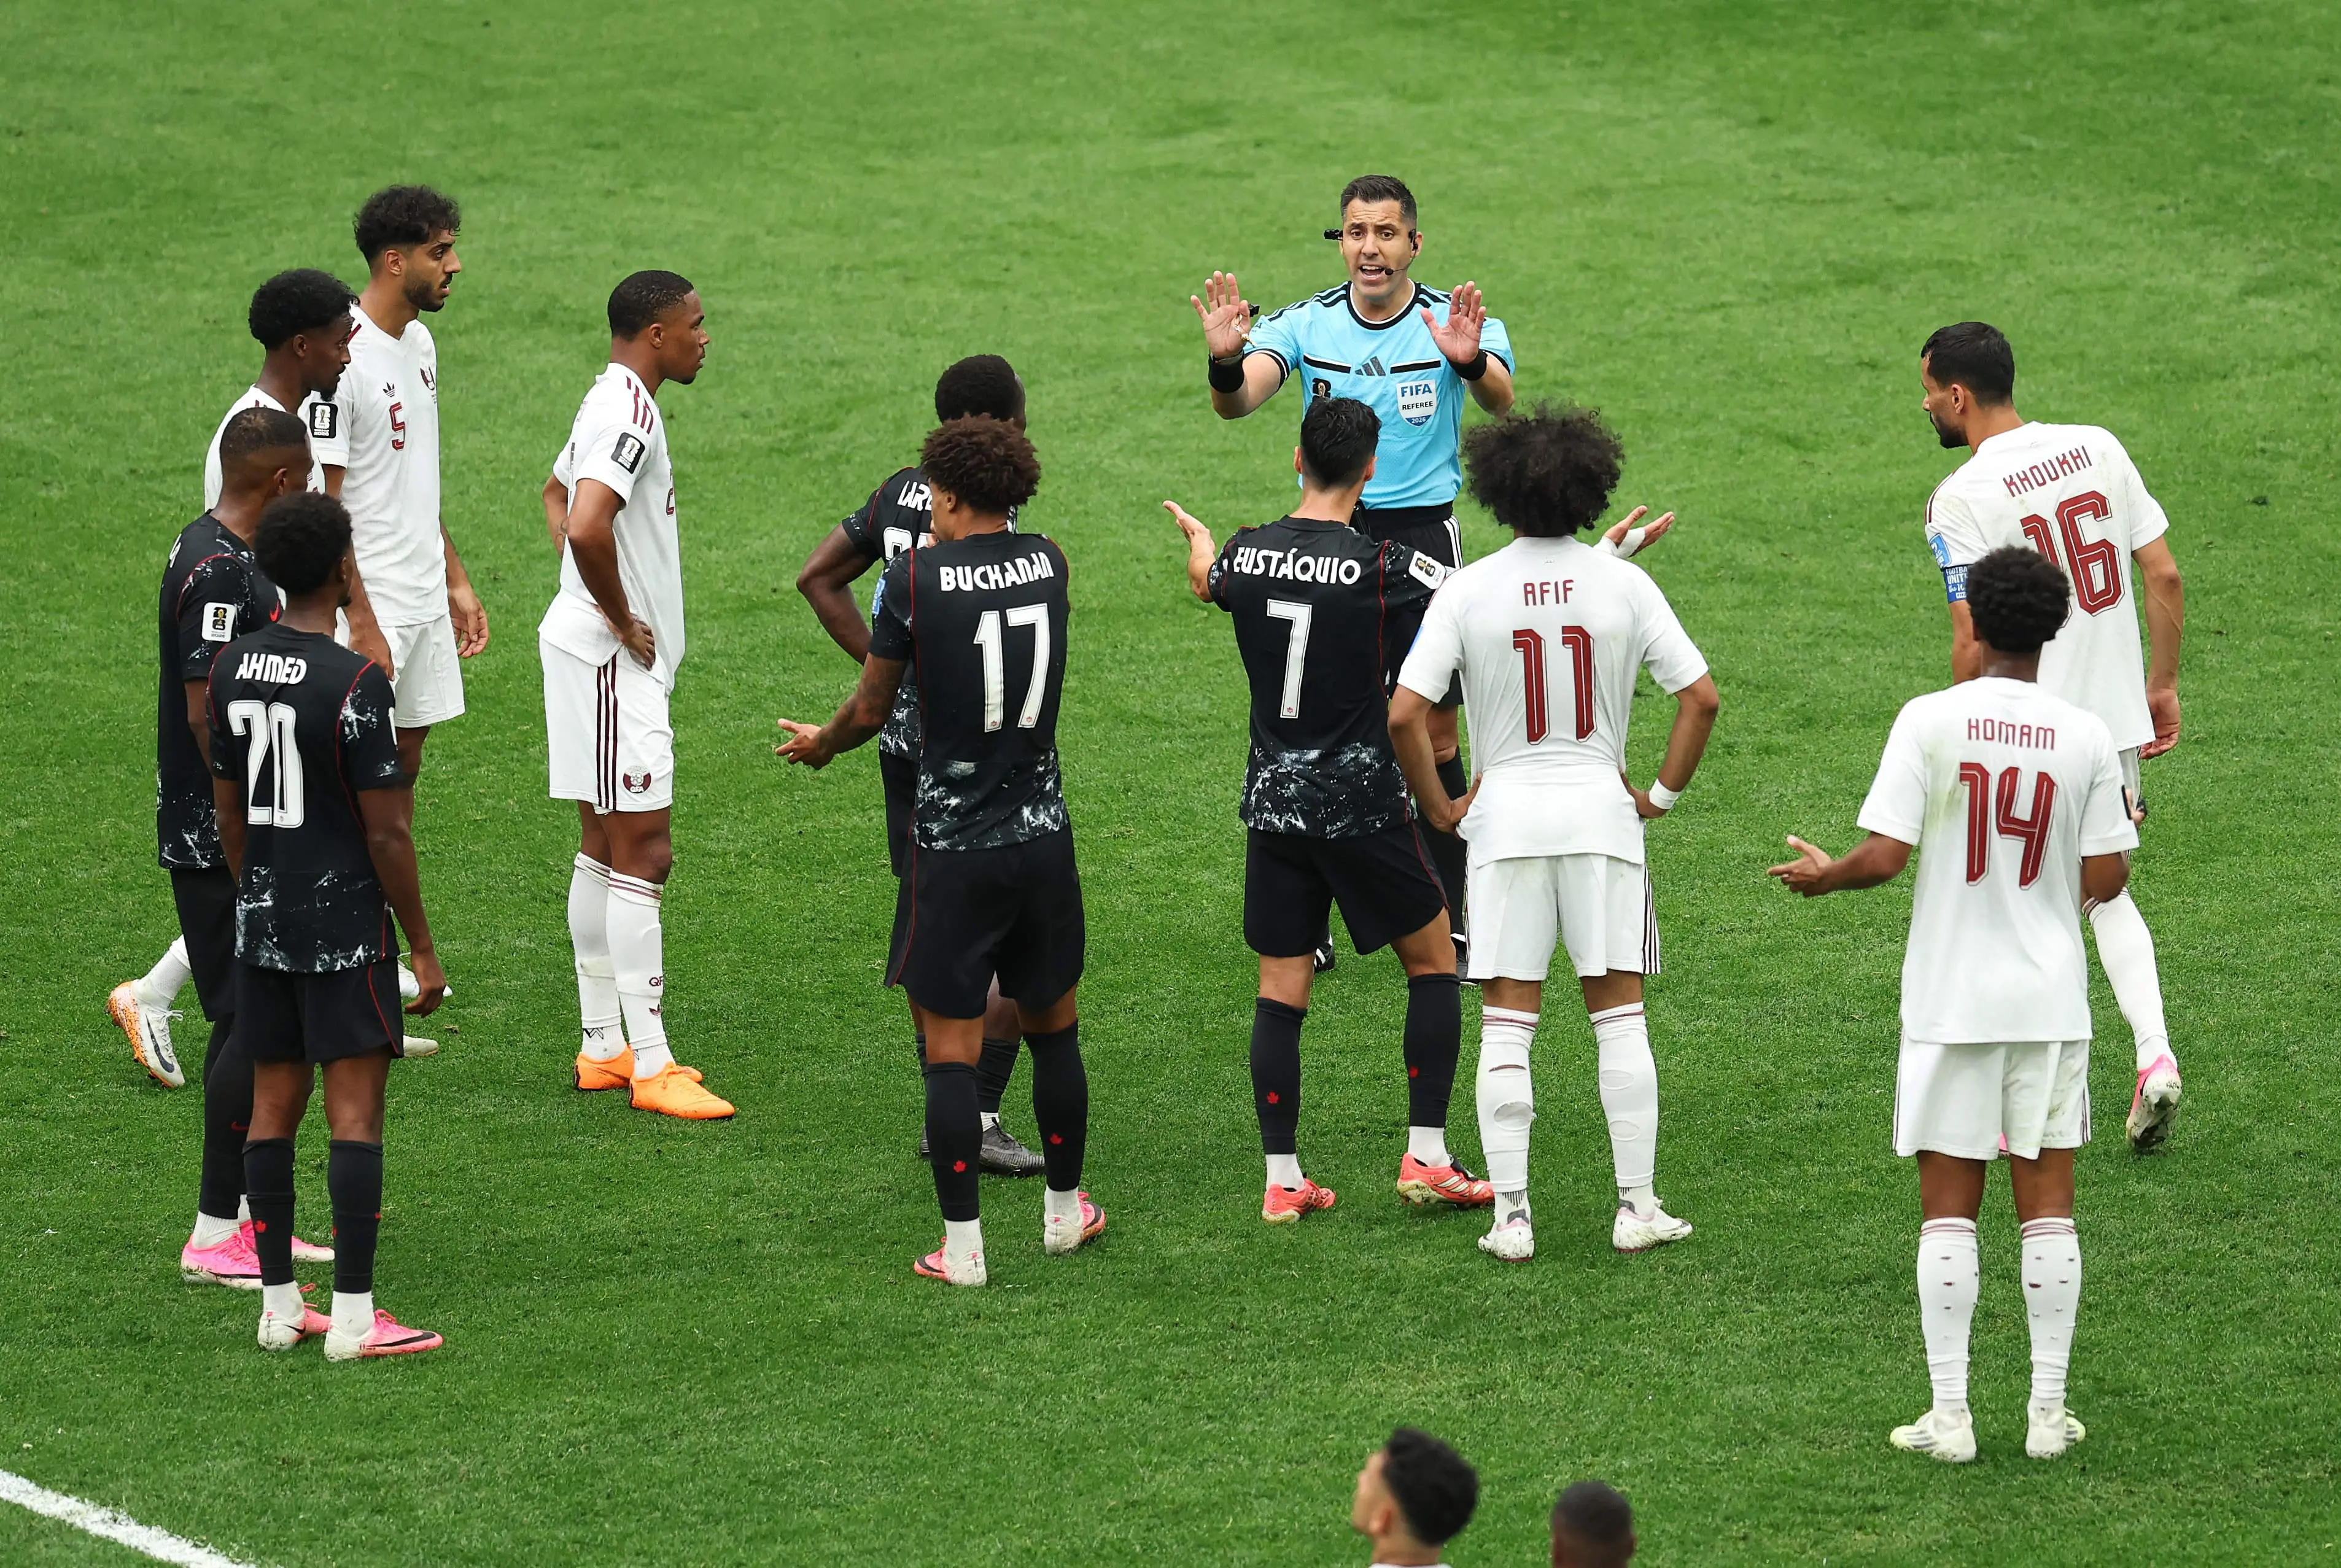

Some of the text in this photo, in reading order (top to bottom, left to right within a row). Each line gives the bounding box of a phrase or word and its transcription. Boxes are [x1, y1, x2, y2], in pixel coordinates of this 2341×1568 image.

[1400, 383, 1432, 397] FIFA
[1402, 401, 1434, 410] REFEREE
[389, 402, 406, 451] 5
[2003, 445, 2093, 497] KHOUKHI
[939, 551, 1054, 591] BUCHANAN
[1233, 546, 1361, 586] EUSTÁQUIO
[2020, 490, 2126, 626] 16
[1524, 579, 1574, 607] AFIF
[235, 652, 307, 685] AHMED
[973, 603, 1050, 732] 17
[1267, 599, 1313, 719] 7
[1513, 626, 1596, 745] 11
[1967, 718, 2055, 751] HOMAM
[227, 699, 305, 829] 20
[1959, 762, 2058, 891] 14
